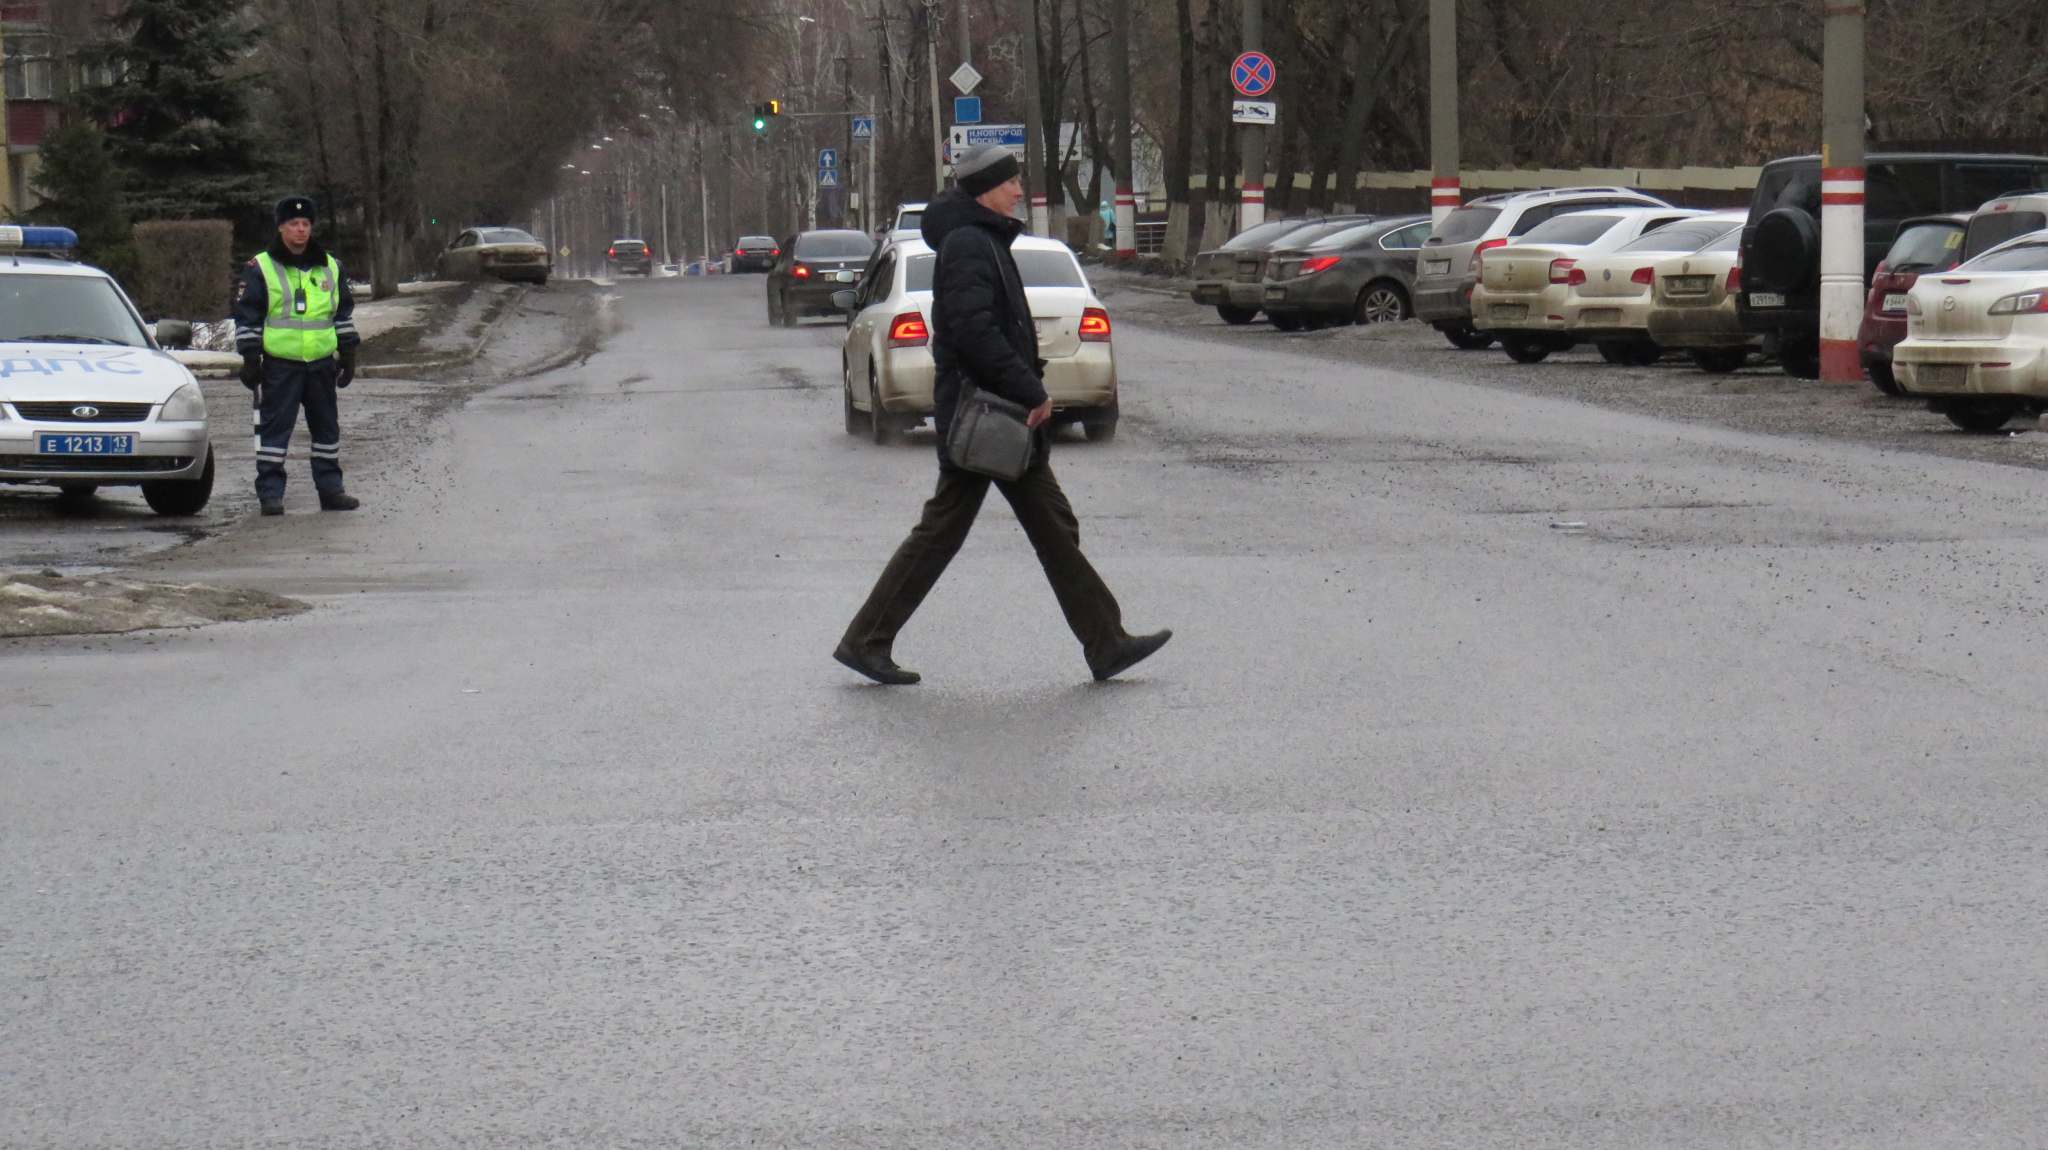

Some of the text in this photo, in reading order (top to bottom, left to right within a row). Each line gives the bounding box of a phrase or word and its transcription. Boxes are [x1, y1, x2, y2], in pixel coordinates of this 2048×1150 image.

[968, 129, 1023, 137] Н.НОВГОРОД
[969, 137, 1004, 145] МОСКВА
[0, 358, 143, 378] ДПС
[47, 436, 128, 453] Е 1213 13
